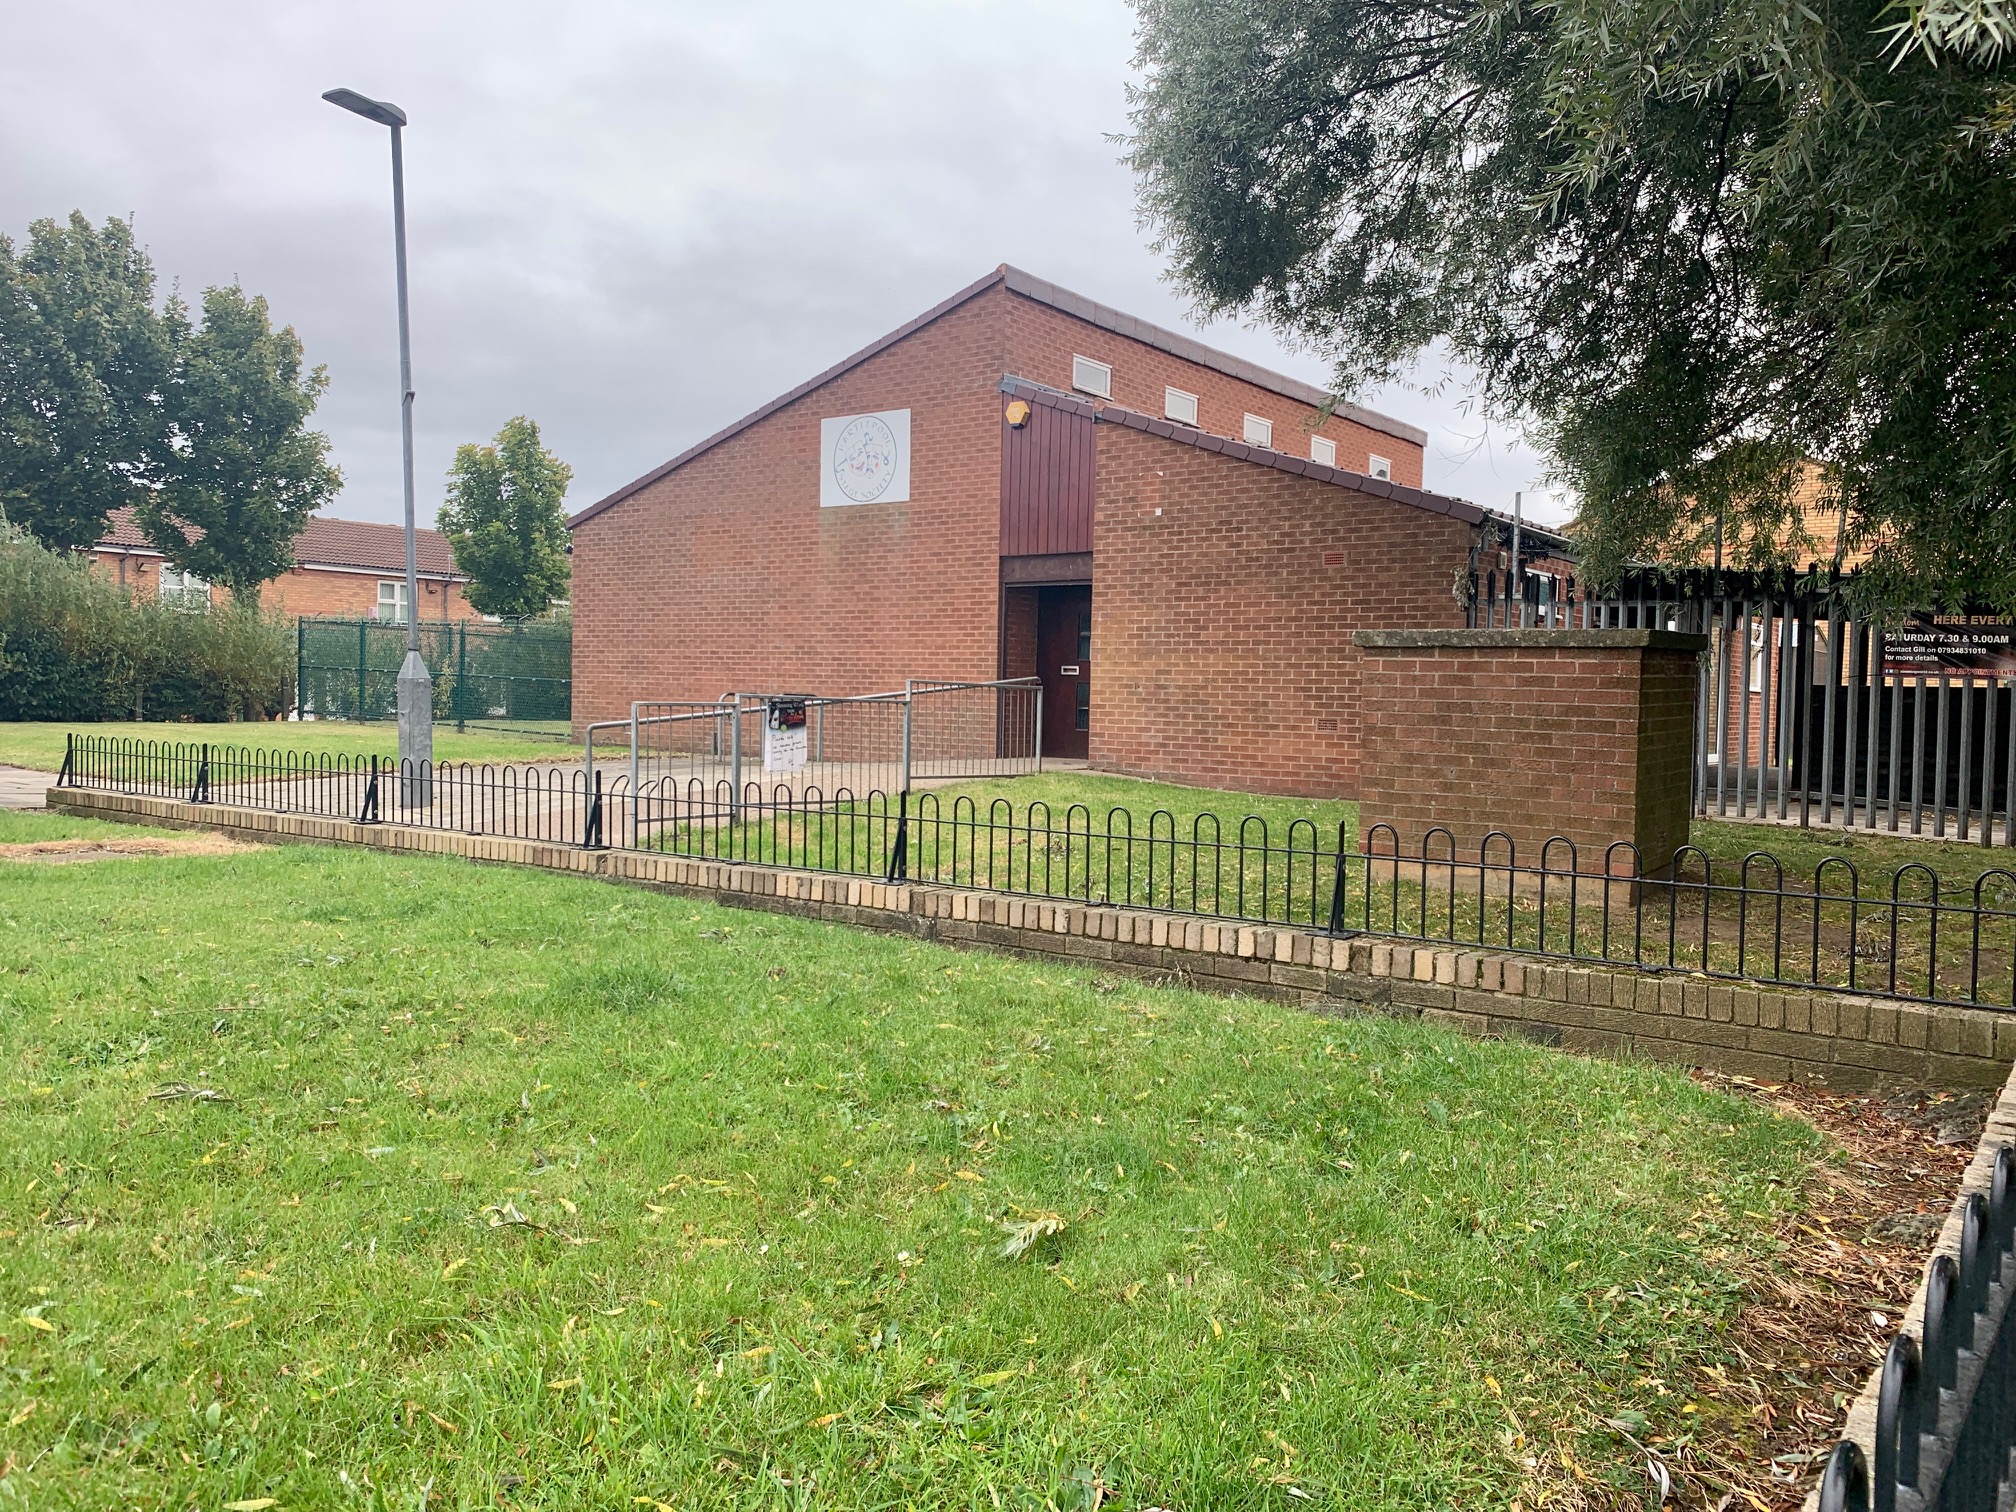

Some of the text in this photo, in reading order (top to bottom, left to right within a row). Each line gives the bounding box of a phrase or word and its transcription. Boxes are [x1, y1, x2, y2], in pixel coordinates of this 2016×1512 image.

[839, 420, 891, 452] HARTLEPOOL
[860, 470, 892, 499] SOCIETY
[1933, 615, 2013, 626] HERE EVERY
[1938, 634, 1960, 643] 7.30
[1962, 634, 1970, 643] &
[1972, 635, 2009, 644] 9.00AM
[1885, 645, 1912, 653] Contact
[1937, 646, 1987, 654] 07934831010
[1914, 654, 1939, 662] details
